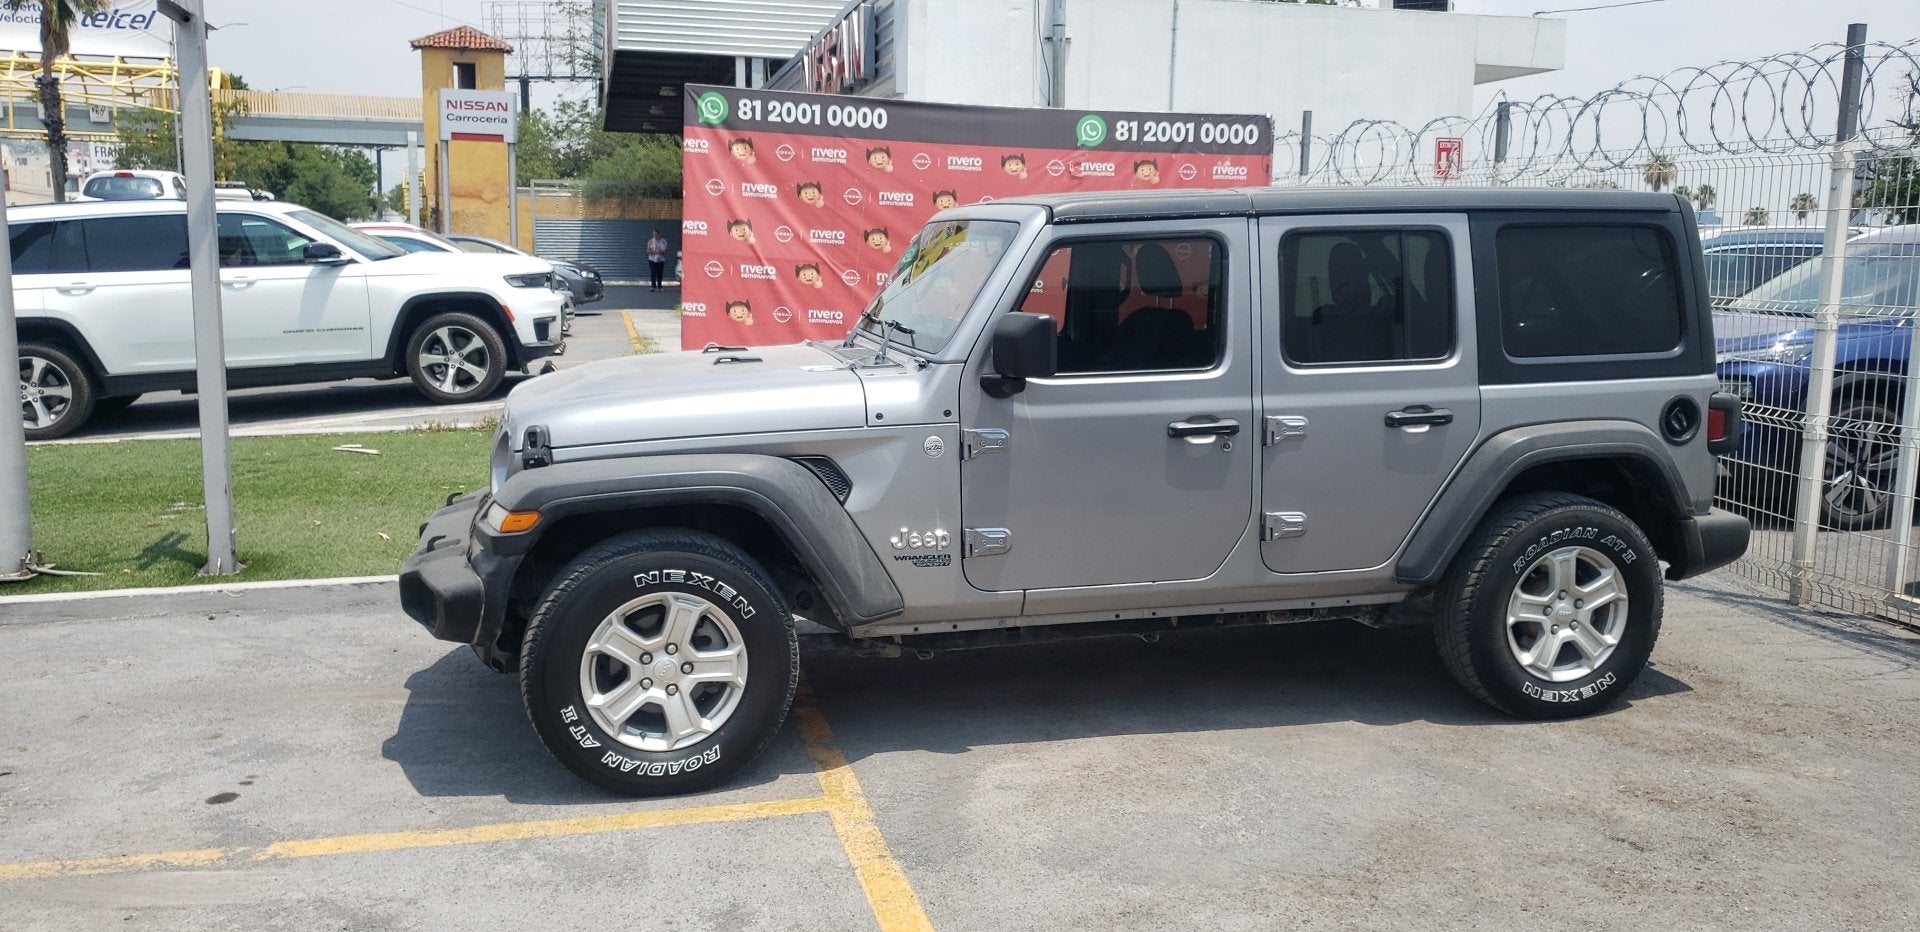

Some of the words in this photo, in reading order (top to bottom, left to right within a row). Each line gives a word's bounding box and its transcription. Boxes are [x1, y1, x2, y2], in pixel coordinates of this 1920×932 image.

[447, 100, 508, 112] NISSAN
[738, 99, 762, 121] 81
[768, 101, 821, 125] 2001
[827, 105, 888, 129] 0000
[1116, 120, 1138, 141] 81
[1143, 121, 1195, 143] 2001
[1200, 123, 1259, 145] 0000
[812, 148, 847, 158] rivero
[948, 156, 982, 166] rivero
[1080, 162, 1115, 171] rivero
[1212, 165, 1247, 175] rivero
[742, 182, 777, 194] rivero
[879, 191, 914, 201] rivero
[810, 229, 845, 239] rivero
[740, 264, 776, 274] rivero
[808, 309, 843, 320] rivero
[891, 527, 951, 551] Jeep
[1513, 527, 1598, 574] ROADIAN
[1600, 535, 1627, 551] AT
[893, 554, 952, 562] WRANGLER
[633, 569, 756, 620] NEXEN
[1522, 672, 1617, 702] NEXEN
[568, 725, 601, 748] AT
[601, 744, 721, 776] ROADIAN
